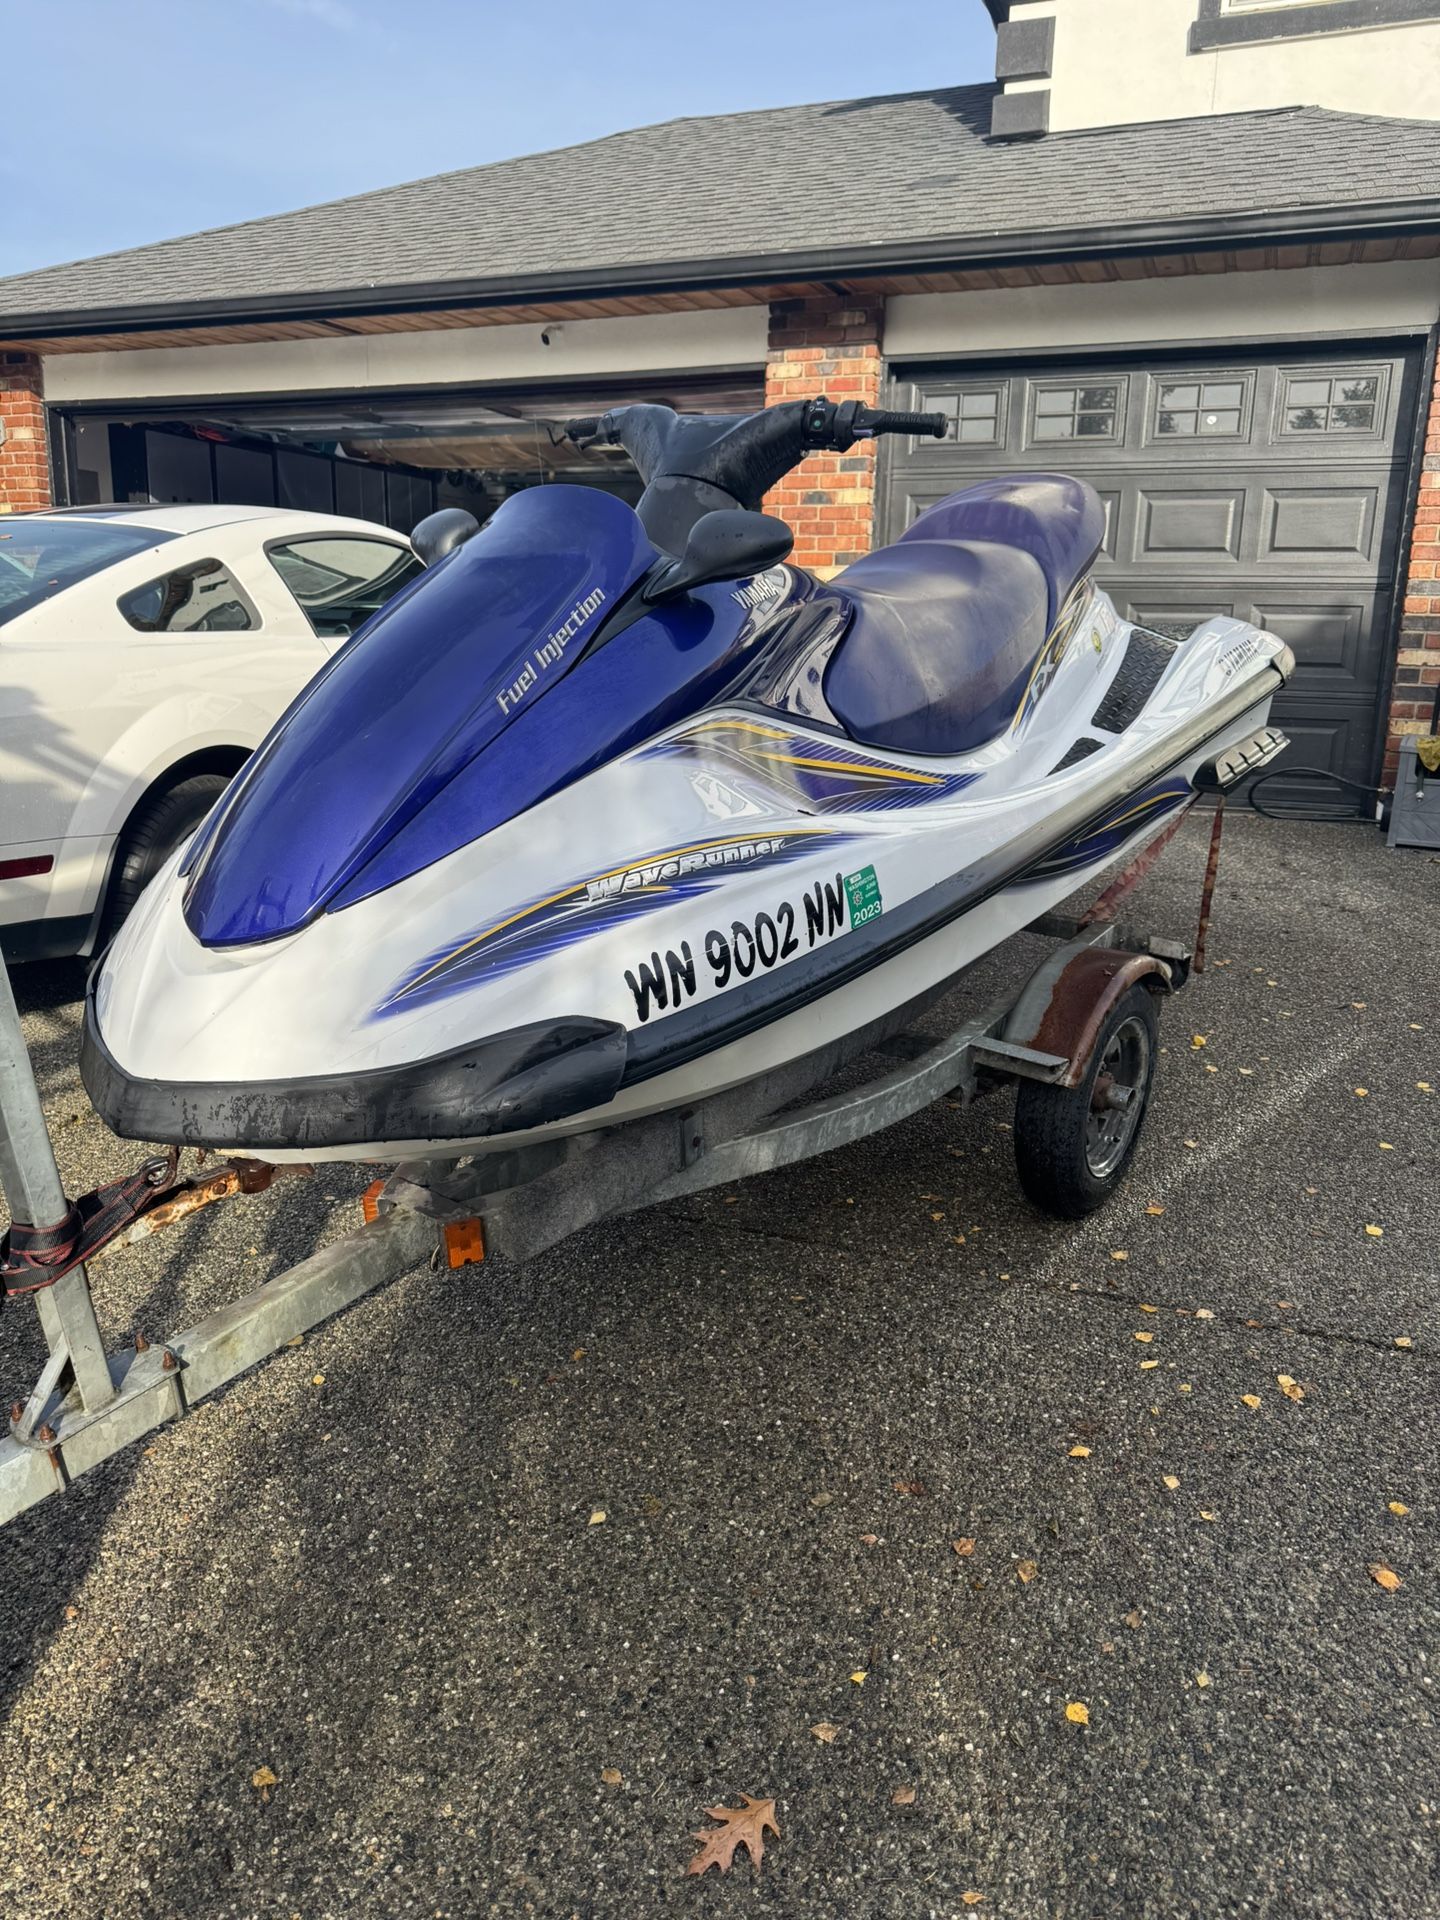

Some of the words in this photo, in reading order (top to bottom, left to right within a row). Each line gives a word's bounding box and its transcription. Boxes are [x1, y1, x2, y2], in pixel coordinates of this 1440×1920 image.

[730, 578, 780, 610] YAMAHA
[496, 661, 538, 715] Fuel
[533, 587, 606, 670] Injection
[586, 839, 785, 901] WaveRunner
[853, 900, 881, 926] 2023
[624, 941, 697, 1022] WN
[704, 902, 799, 988] 9002
[803, 872, 844, 947] NN
